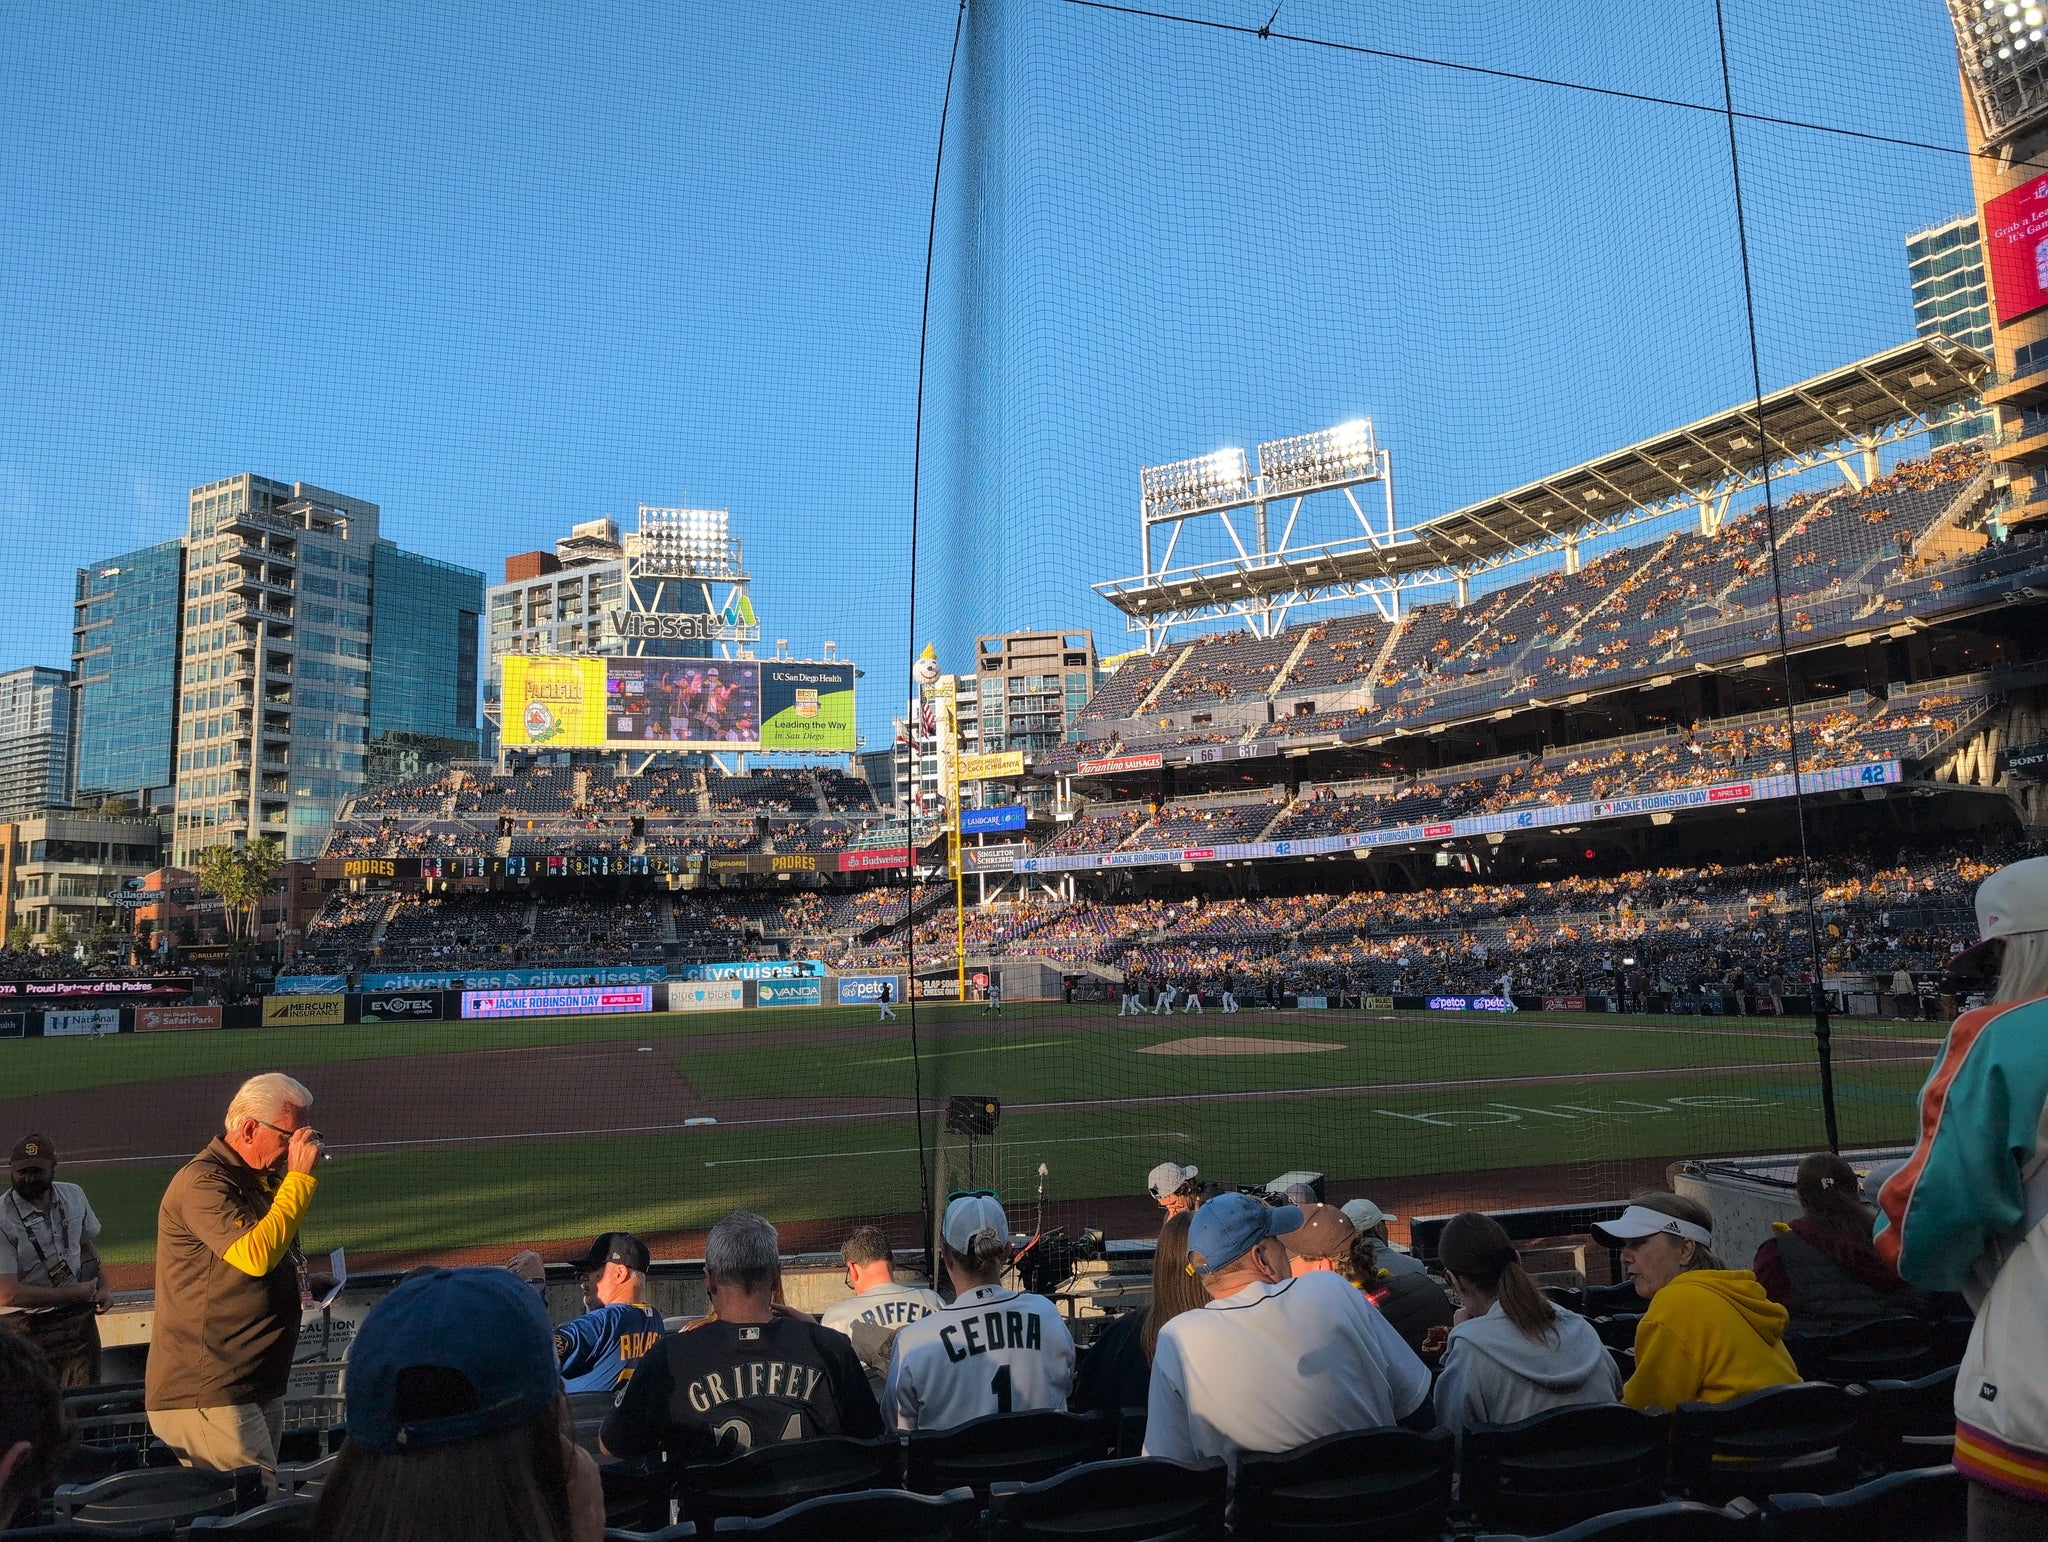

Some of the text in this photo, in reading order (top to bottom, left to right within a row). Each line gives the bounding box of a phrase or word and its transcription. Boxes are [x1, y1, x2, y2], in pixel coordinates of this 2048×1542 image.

[1994, 222, 2020, 239] Grab
[2008, 230, 2025, 244] It's
[610, 610, 715, 639] Viasat
[772, 672, 842, 683] UC San Diego Health
[774, 720, 847, 730] Leading the Way
[785, 732, 800, 740] San
[1238, 745, 1258, 757] 6:17
[984, 761, 1020, 770] ICHIBANYA
[1079, 758, 1161, 774] Tarantino SAUSAGES
[2009, 754, 2045, 767] SONY
[1861, 764, 1886, 783] 42
[1612, 799, 1641, 814] JACKIE
[1641, 794, 1688, 809] ROBINSON
[1689, 790, 1709, 804] DAY
[1716, 790, 1735, 798] APRIL
[967, 816, 1001, 826] LANDCARE
[1517, 812, 1533, 826] 42
[1357, 833, 1378, 845] JACKIE
[1377, 830, 1410, 843] ROBINSON
[1410, 828, 1423, 839] DAY
[977, 849, 1015, 857] SINGLETON
[1275, 842, 1291, 855] 42
[435, 857, 442, 867] 3
[478, 857, 485, 867] 9
[521, 857, 526, 866] 1
[561, 857, 568, 867] 4
[602, 856, 608, 866] 3
[643, 856, 648, 865] 1
[772, 855, 816, 872] PADRES
[862, 852, 908, 866] Budweiser
[977, 857, 1014, 865] SCHREIBER
[1111, 854, 1134, 865] JACKIE
[1134, 852, 1170, 863] ROBINSON
[1170, 851, 1184, 861] DAY
[343, 859, 395, 876] PADRES
[451, 862, 457, 872] F
[493, 862, 499, 872] F
[535, 862, 541, 872] F
[576, 861, 582, 871] 9
[602, 866, 608, 875] 0
[616, 861, 623, 870] 5
[642, 865, 649, 875] 0
[656, 860, 662, 870] 7
[1024, 860, 1037, 871] 42
[435, 867, 442, 877] 5
[478, 867, 485, 877] 5
[520, 867, 526, 876] 2
[561, 867, 568, 876] 3
[108, 890, 161, 901] Gallagher
[115, 899, 153, 909] Square
[687, 964, 793, 981] citycruises
[529, 971, 641, 987] citycruises
[923, 979, 960, 989] SLAP SOME
[26, 983, 56, 993] Proud
[93, 982, 102, 992] of
[103, 982, 121, 991] the
[122, 981, 152, 991] Padres
[773, 986, 819, 997] VANDA
[923, 988, 945, 996] CHEESE
[944, 988, 955, 996] ON
[671, 989, 695, 1000] blue
[707, 987, 731, 1000] blue
[290, 1002, 340, 1012] MERCURY
[371, 998, 433, 1012] EVOTEK
[495, 997, 528, 1010] JACKIE
[529, 995, 581, 1008] ROBINSON
[581, 994, 600, 1007] DAY
[608, 996, 626, 1004] APRIL
[1440, 997, 1466, 1009] petco
[72, 1014, 114, 1024] Natnal
[289, 1009, 340, 1018] INSURANCE
[163, 1014, 214, 1026] Safari Park
[1373, 1095, 1785, 1127] blue
[851, 1301, 939, 1327] RIFFEY
[300, 1320, 355, 1334] CAUION
[939, 1311, 1042, 1364] CEDRA
[689, 1361, 823, 1413] GRIFFEY
